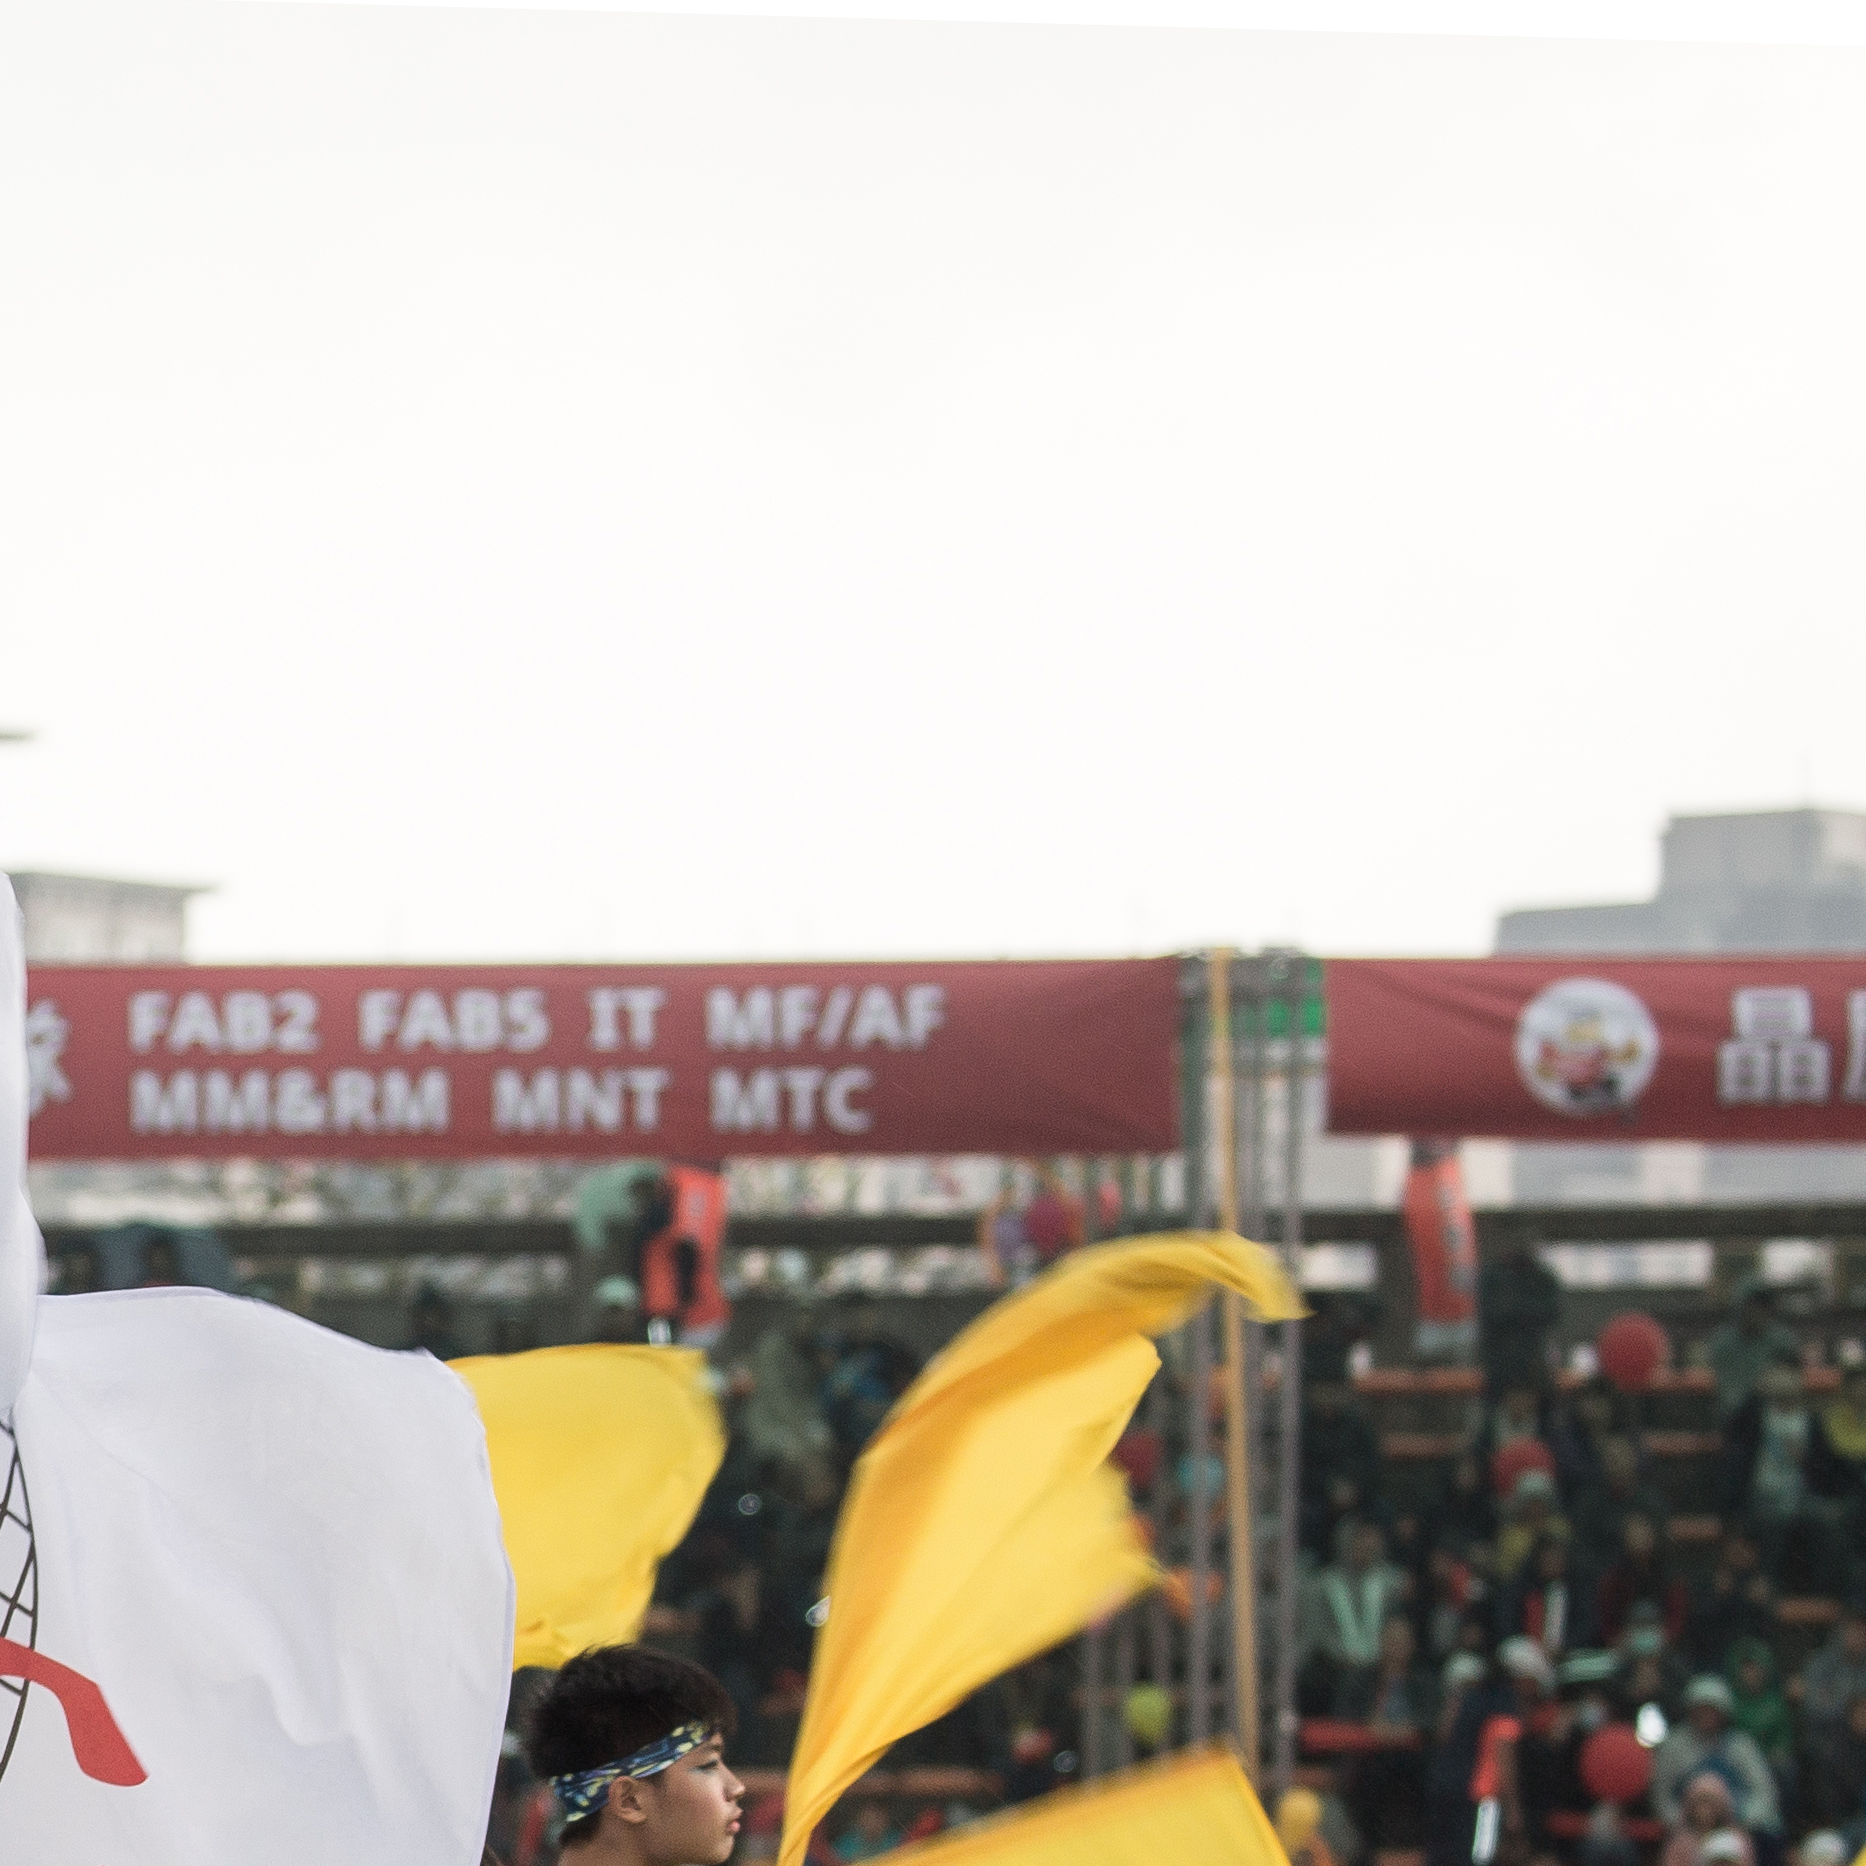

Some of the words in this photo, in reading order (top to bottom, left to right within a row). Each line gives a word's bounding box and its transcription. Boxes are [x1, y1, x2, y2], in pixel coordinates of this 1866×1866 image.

[129, 989, 319, 1053] FAB2
[589, 987, 666, 1050] IT
[705, 985, 947, 1050] MF/AF
[1716, 984, 1866, 1106] 晶
[129, 1068, 450, 1135] MM&RM
[491, 1067, 671, 1134] MNT
[710, 1067, 875, 1135] MTC
